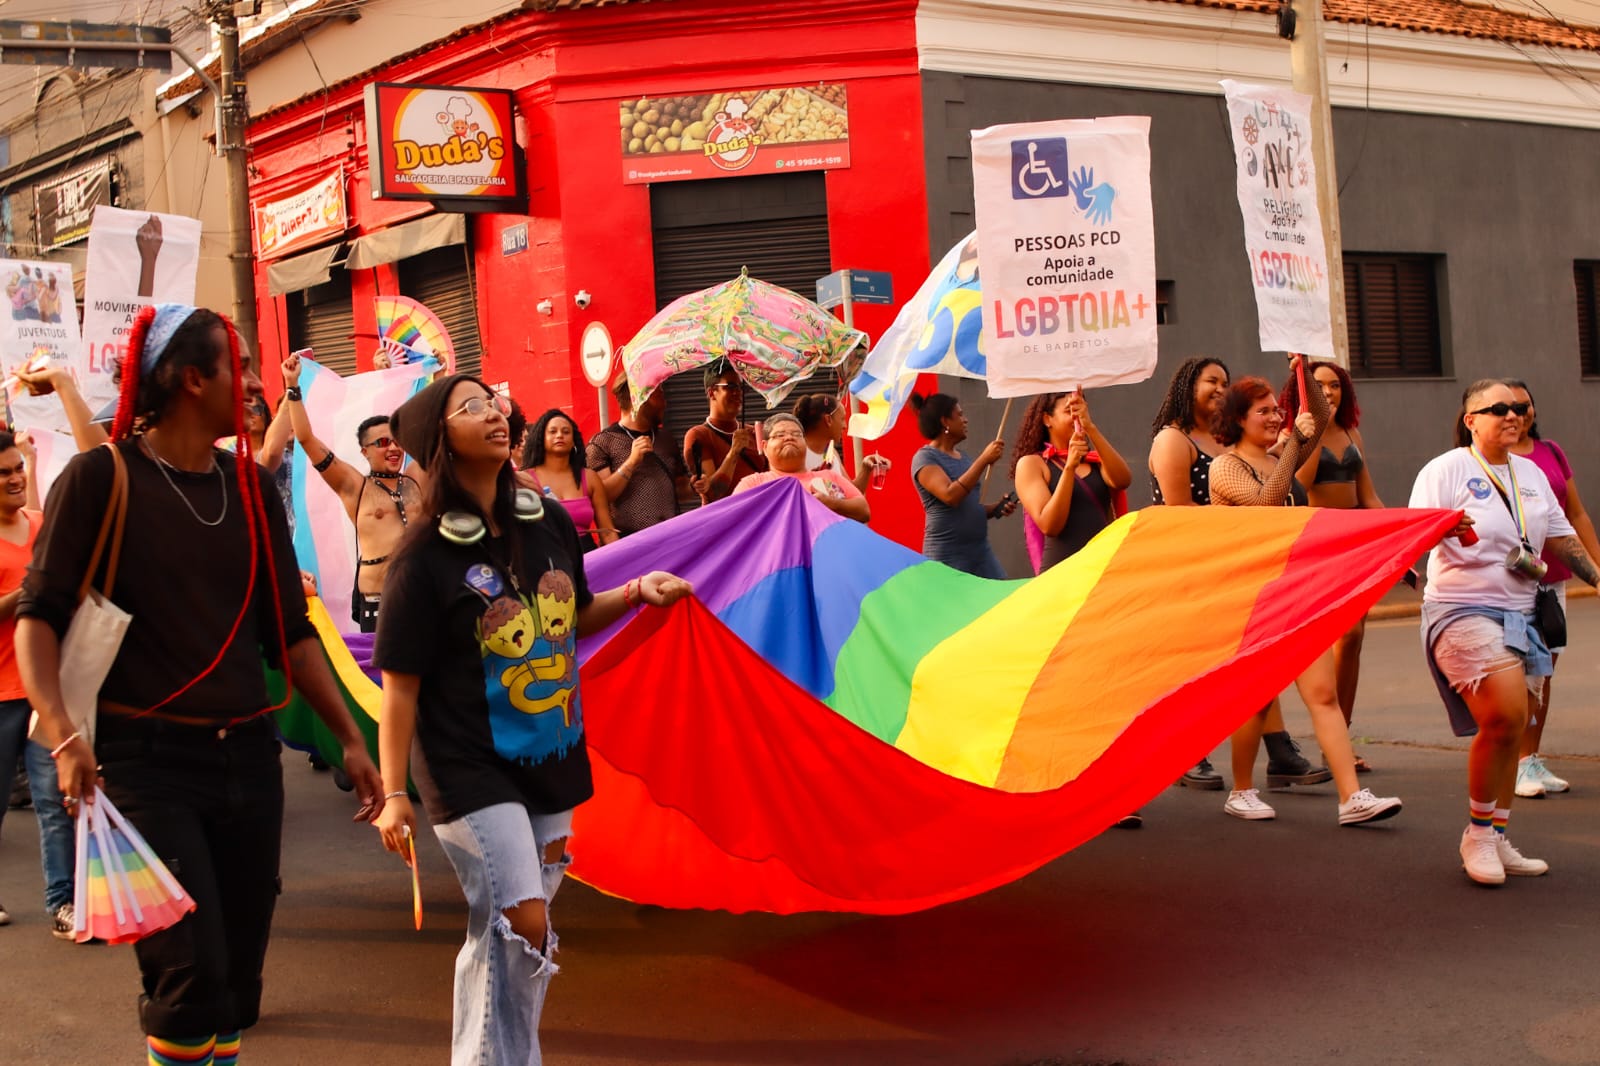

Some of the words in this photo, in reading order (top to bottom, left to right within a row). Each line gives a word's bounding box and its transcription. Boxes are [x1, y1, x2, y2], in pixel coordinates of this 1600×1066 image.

[393, 131, 504, 170] Duda's
[703, 132, 761, 157] Duda's
[394, 174, 447, 185] SALGADERIA
[448, 175, 456, 185] E
[456, 175, 506, 186] PASTELARIA
[503, 233, 516, 251] Rua
[516, 229, 526, 248] 18
[1014, 233, 1086, 252] PESSOAS
[1091, 230, 1121, 246] PCD
[1044, 254, 1084, 272] Apoia
[1087, 255, 1096, 266] a
[1026, 267, 1114, 286] comunidade
[994, 289, 1150, 339] LGBTQIA+
[18, 327, 68, 340] JUVENTUDE
[1023, 344, 1039, 353] DE
[1045, 338, 1110, 352] BARRETOS
